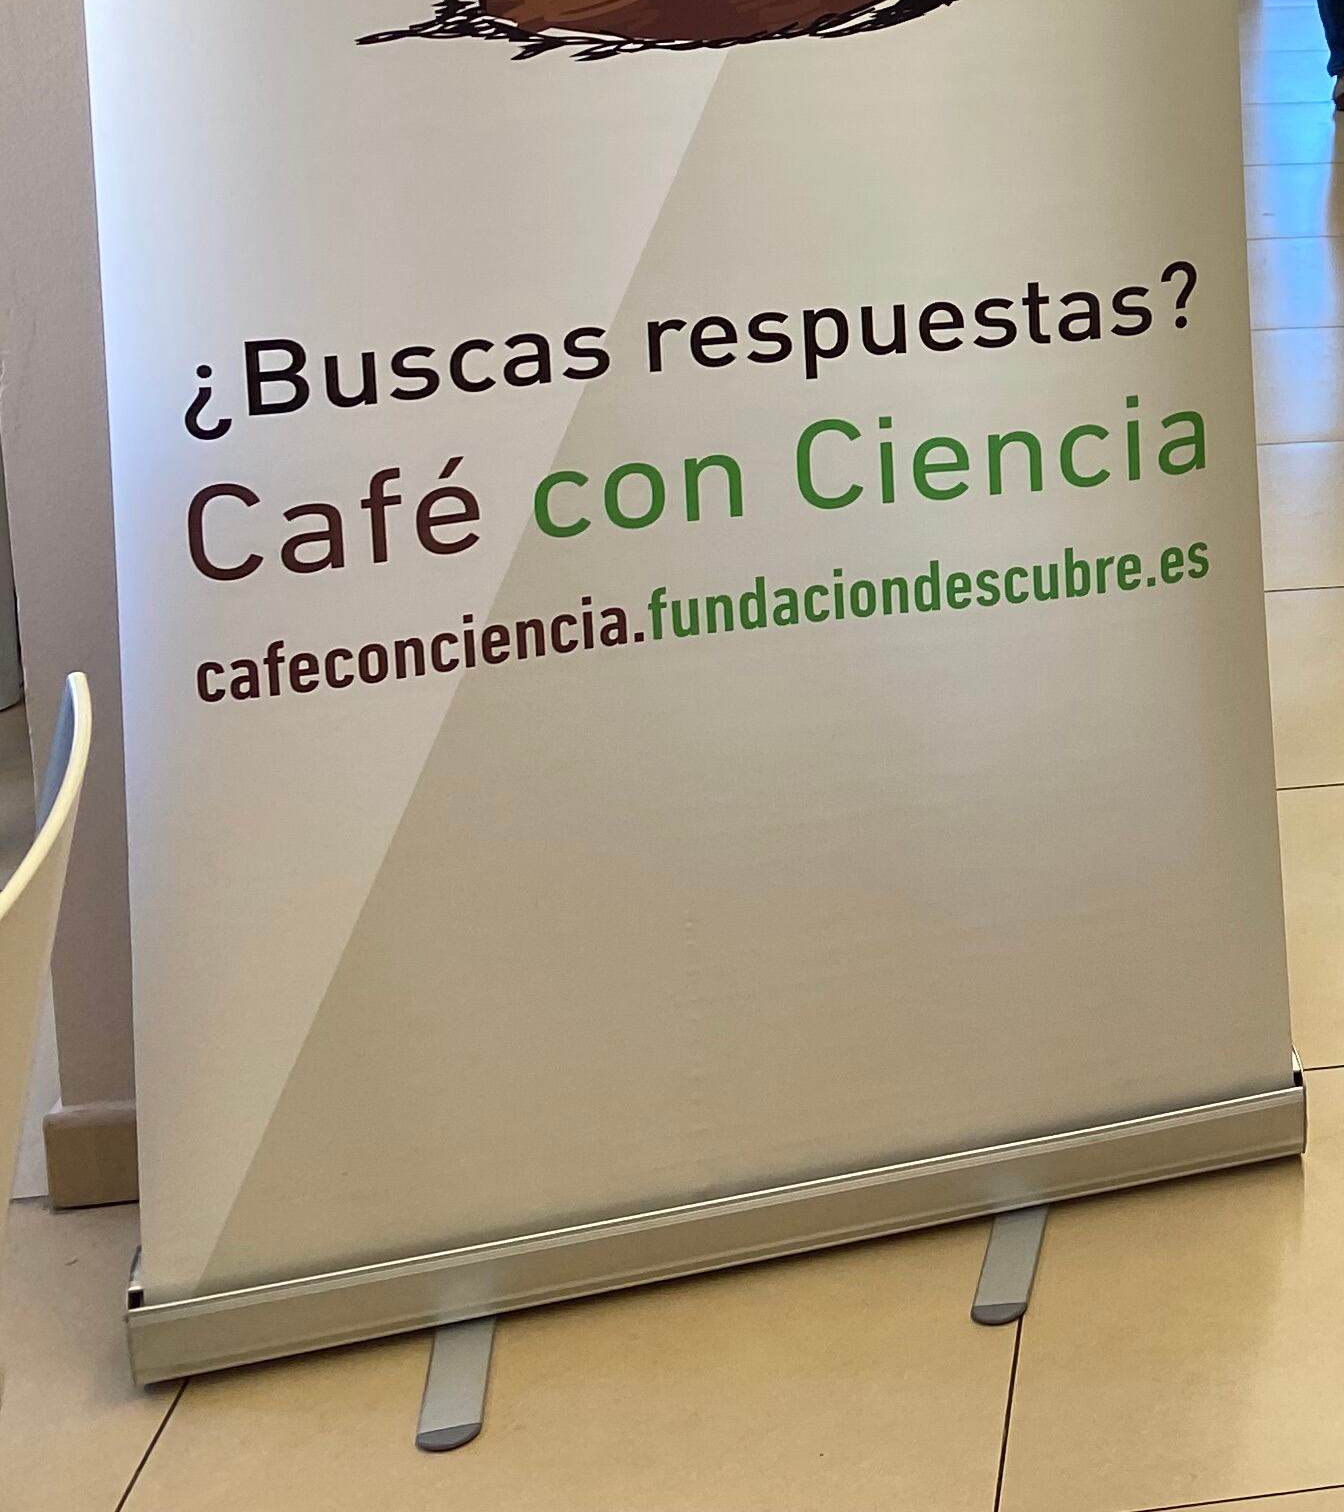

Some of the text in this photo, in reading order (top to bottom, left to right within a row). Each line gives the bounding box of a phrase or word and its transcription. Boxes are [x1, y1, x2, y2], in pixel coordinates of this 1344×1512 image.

[183, 261, 1198, 441] ¿Buscas respuestas?
[187, 394, 1207, 582] Café con Ciencia
[195, 540, 1211, 703] cafeconciencia.fundaciondescubre.es
